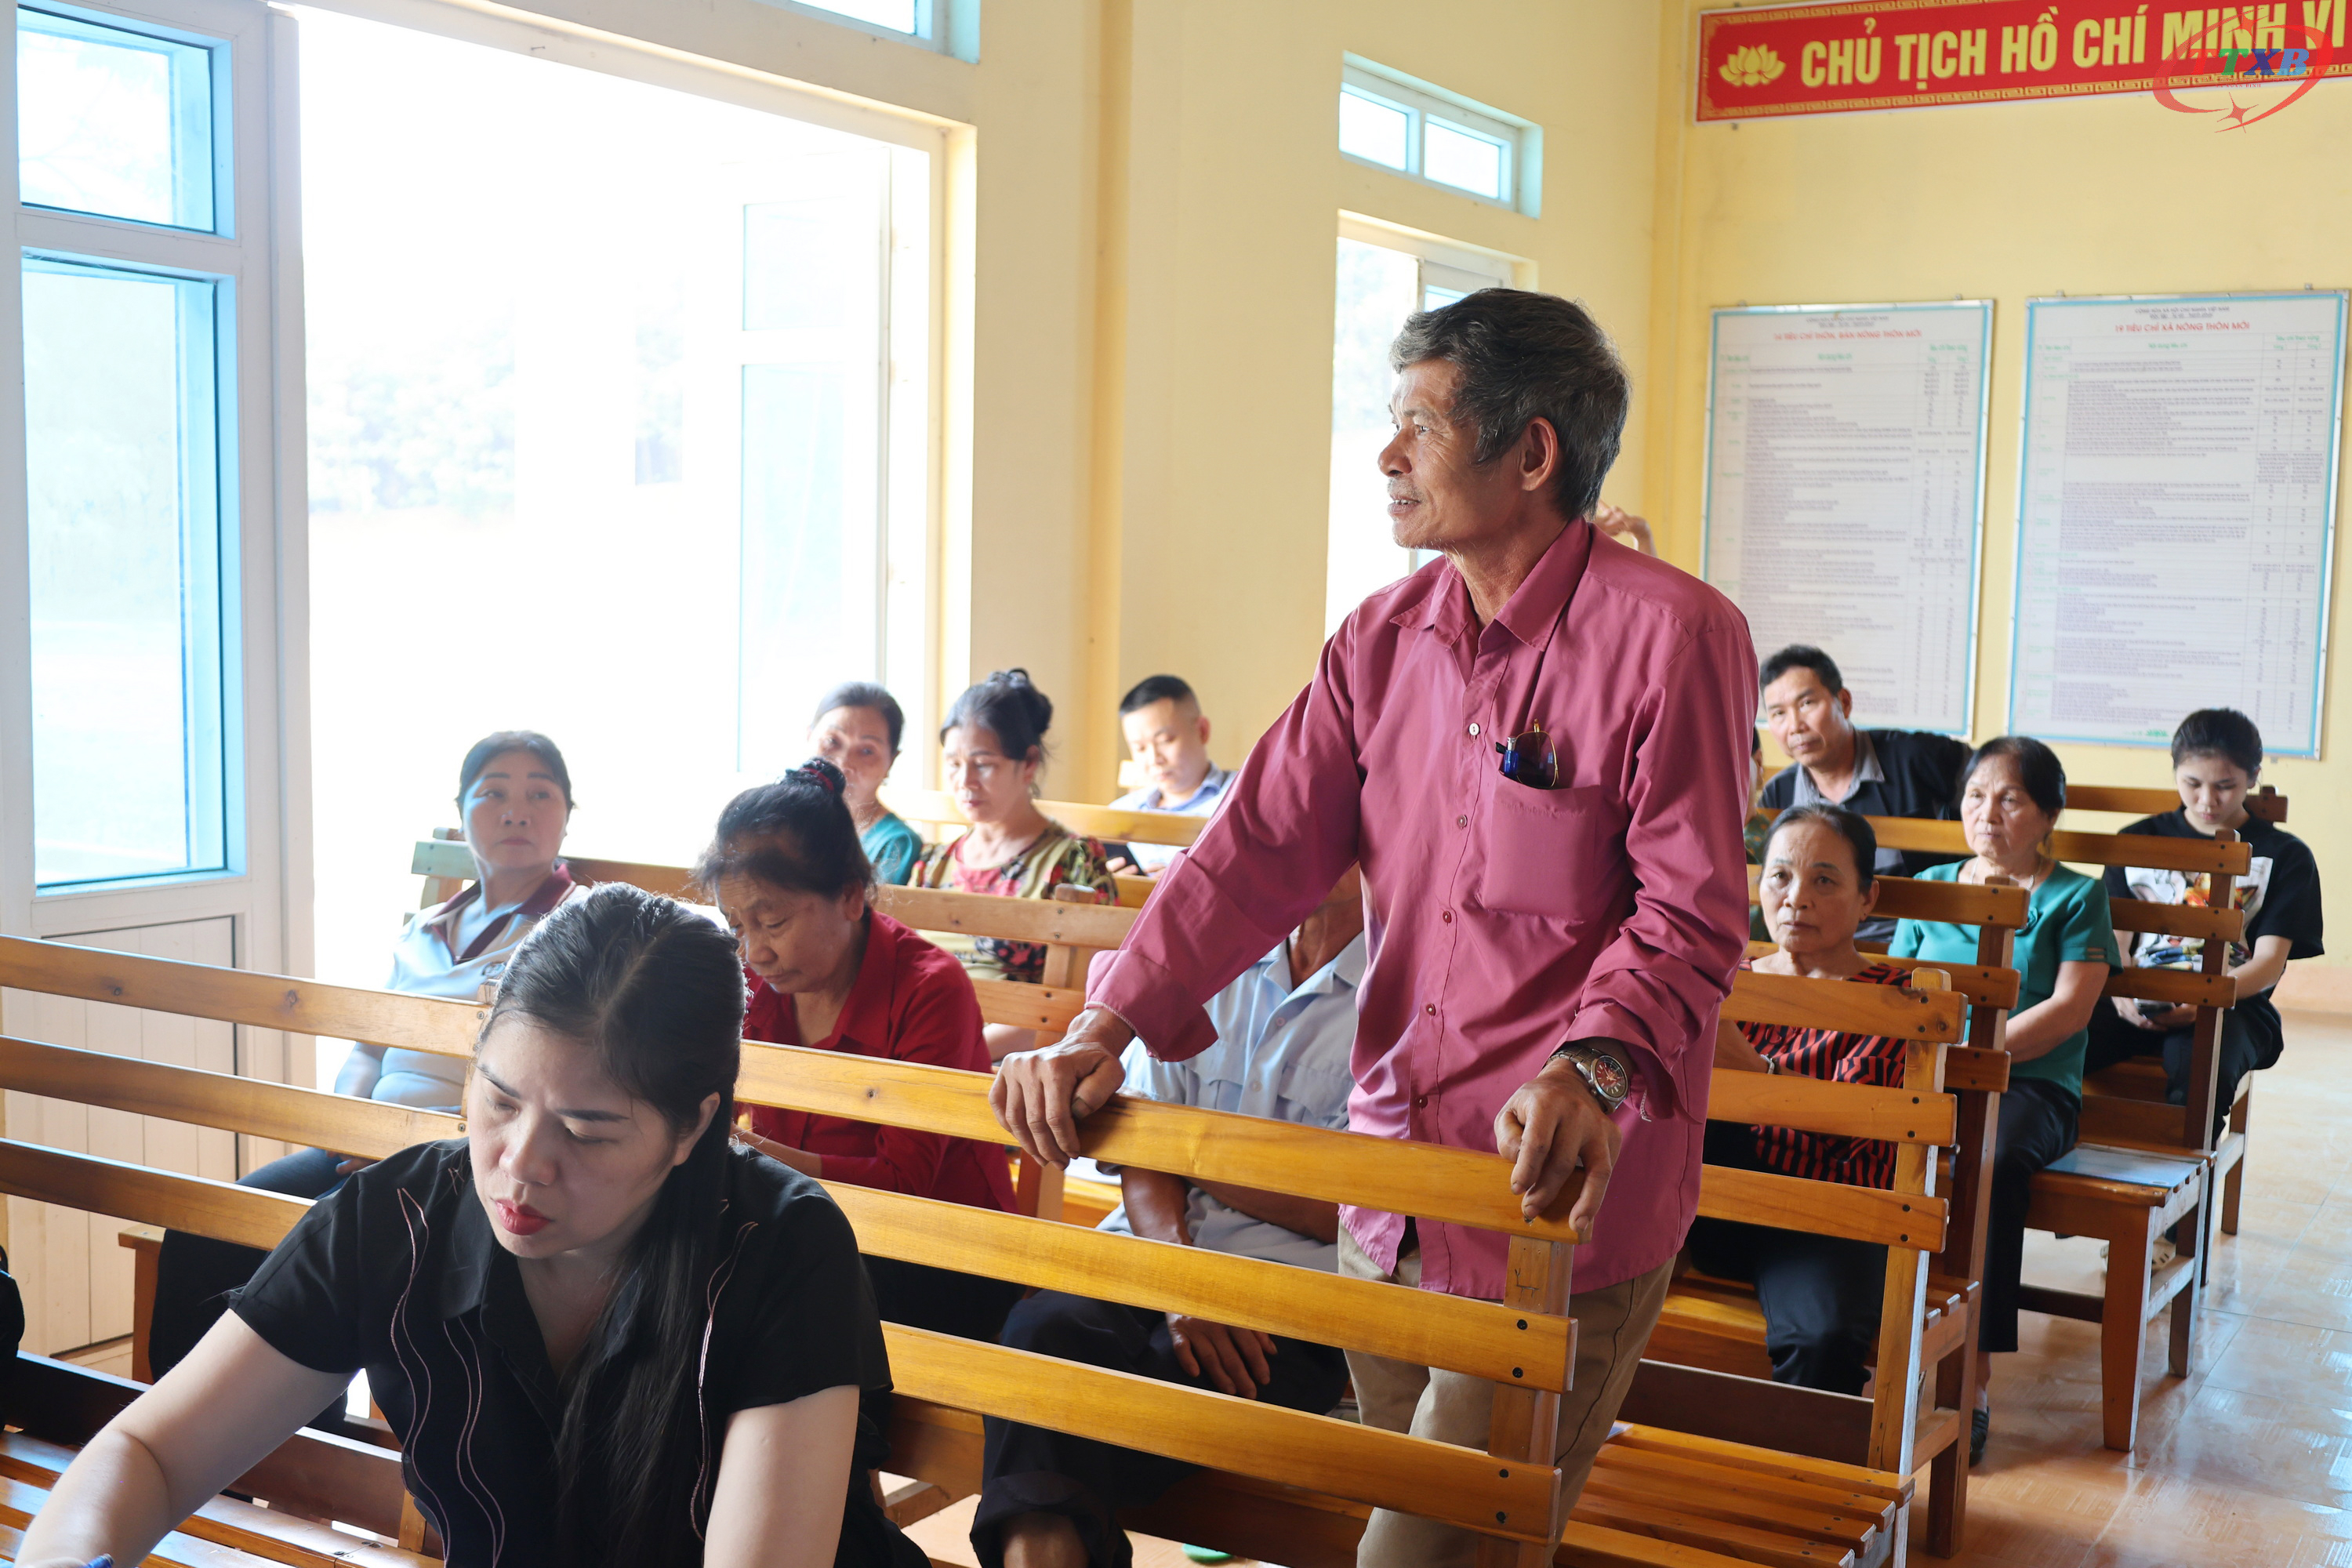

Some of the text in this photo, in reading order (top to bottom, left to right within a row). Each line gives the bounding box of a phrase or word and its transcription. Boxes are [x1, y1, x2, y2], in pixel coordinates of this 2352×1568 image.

[1801, 17, 1882, 88] CHỦ
[1894, 28, 1987, 90] TỊCH
[2001, 5, 2058, 71] HỒ
[2072, 4, 2149, 68] CHÍ
[2161, 3, 2287, 60] MINH
